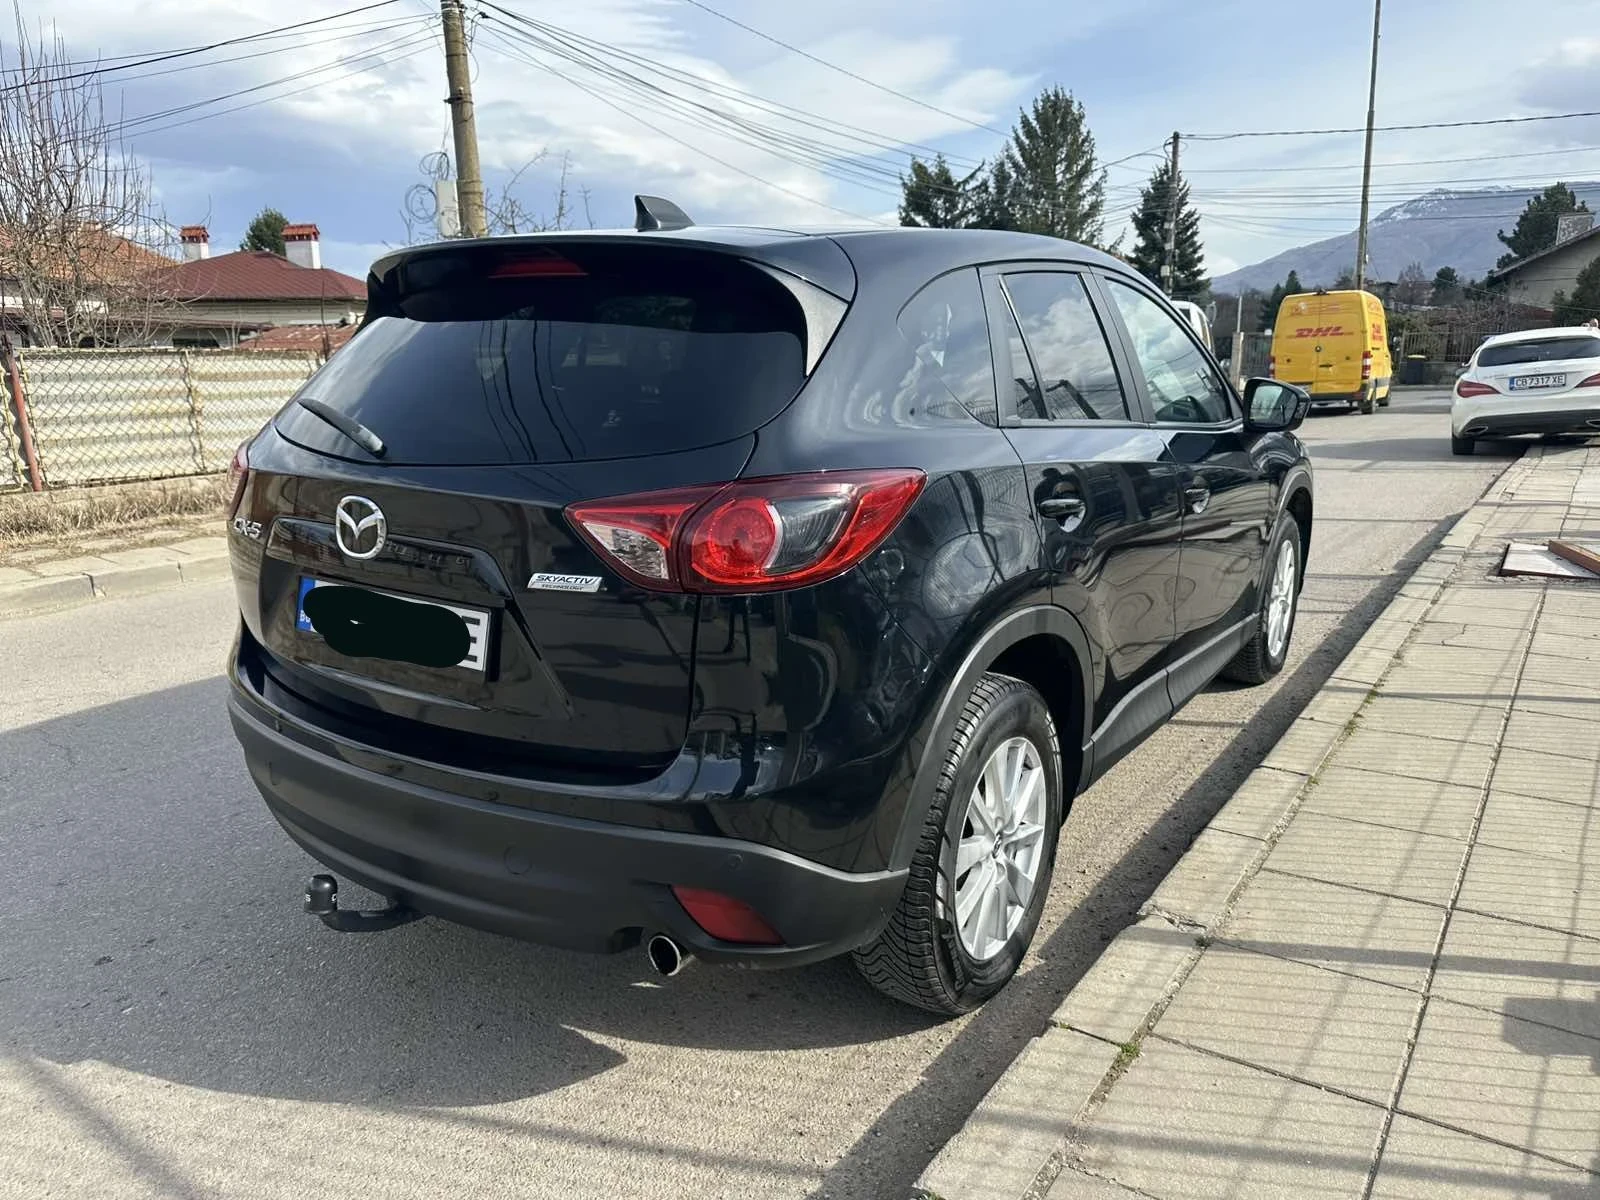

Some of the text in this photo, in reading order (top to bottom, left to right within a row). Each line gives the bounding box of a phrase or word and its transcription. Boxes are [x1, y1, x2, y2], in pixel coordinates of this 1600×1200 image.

[1295, 326, 1344, 338] DHL
[1515, 375, 1563, 387] CB 7317 XE
[535, 574, 594, 584] SKYACTIV
